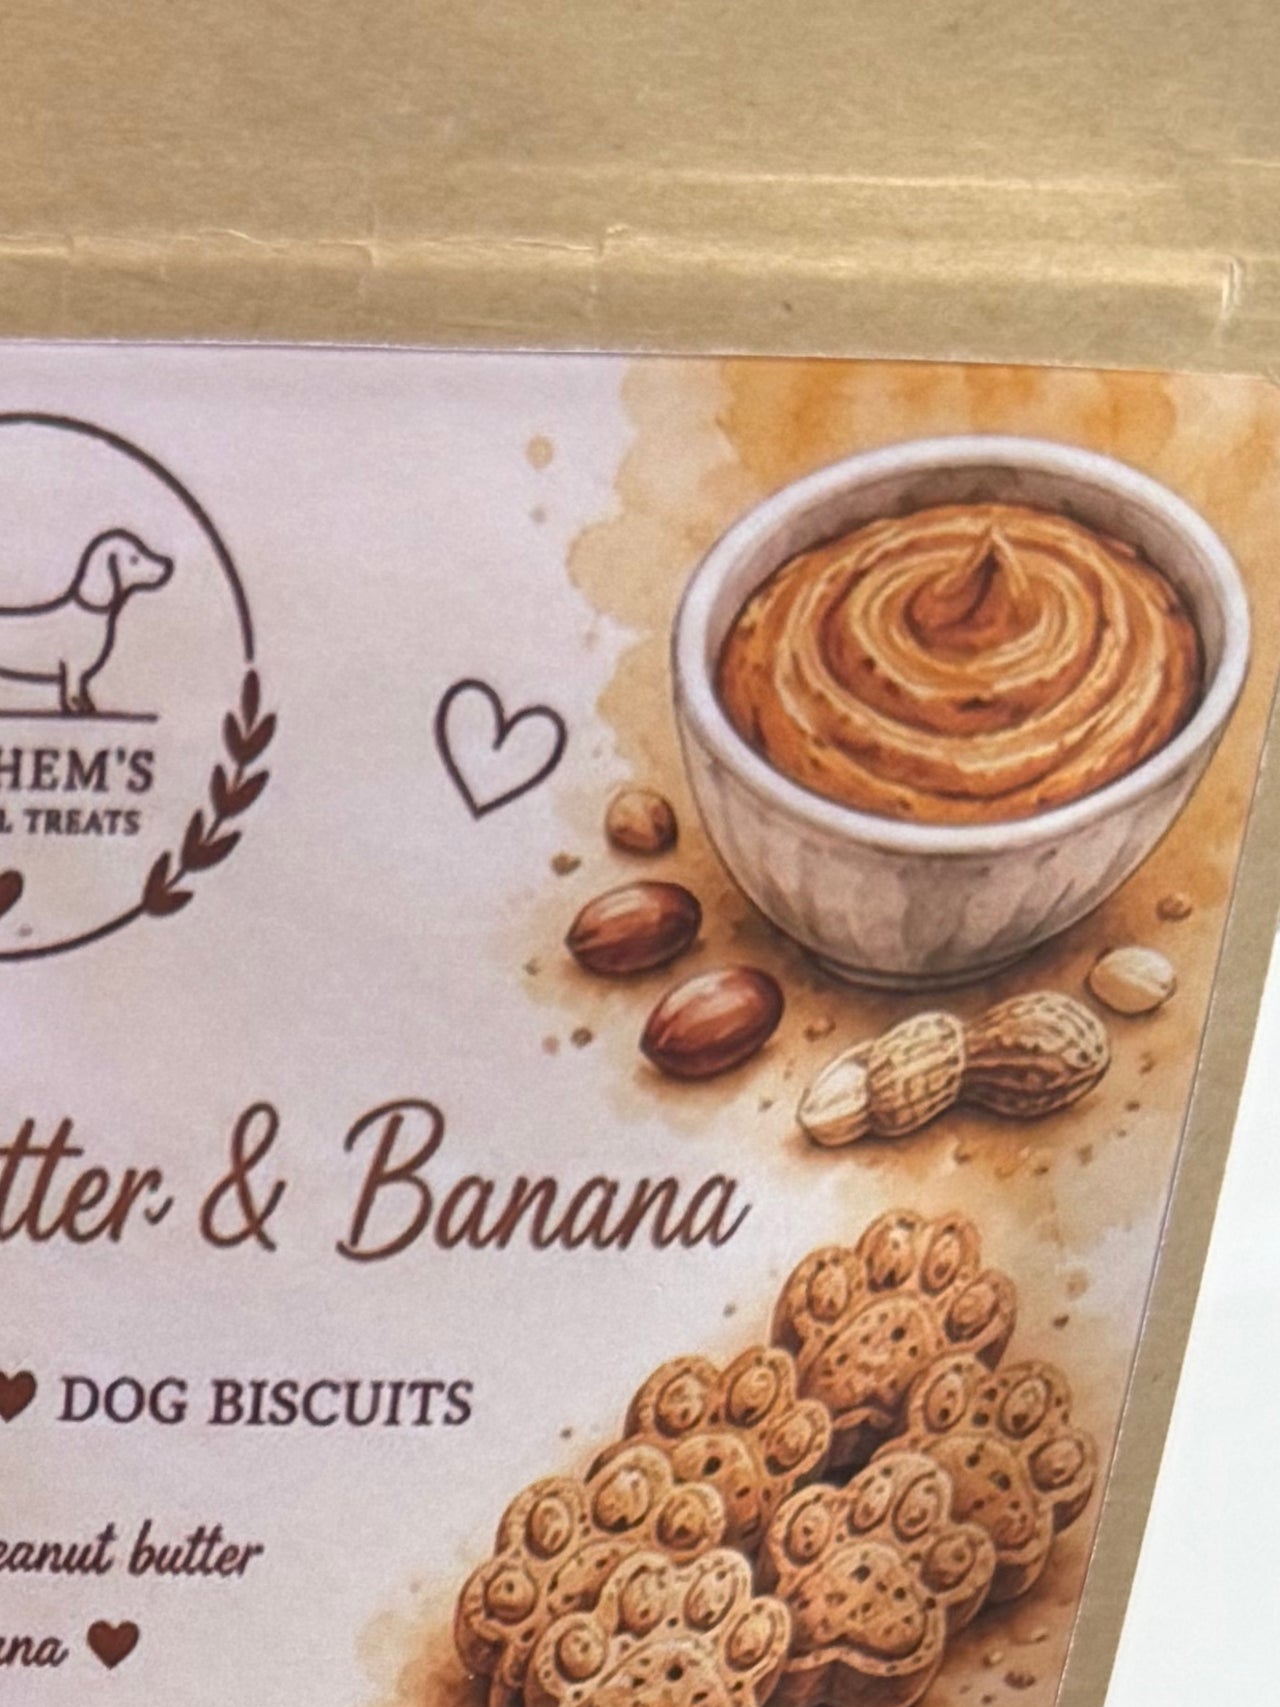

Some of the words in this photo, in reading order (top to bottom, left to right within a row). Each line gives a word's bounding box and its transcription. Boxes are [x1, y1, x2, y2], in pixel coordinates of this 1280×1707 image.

[25, 809, 142, 836] TREATS
[200, 1101, 286, 1252] &
[336, 1099, 752, 1263] Banana
[57, 1375, 188, 1425] DOG
[208, 1378, 474, 1428] BISCUITS
[127, 1519, 265, 1578] butter
